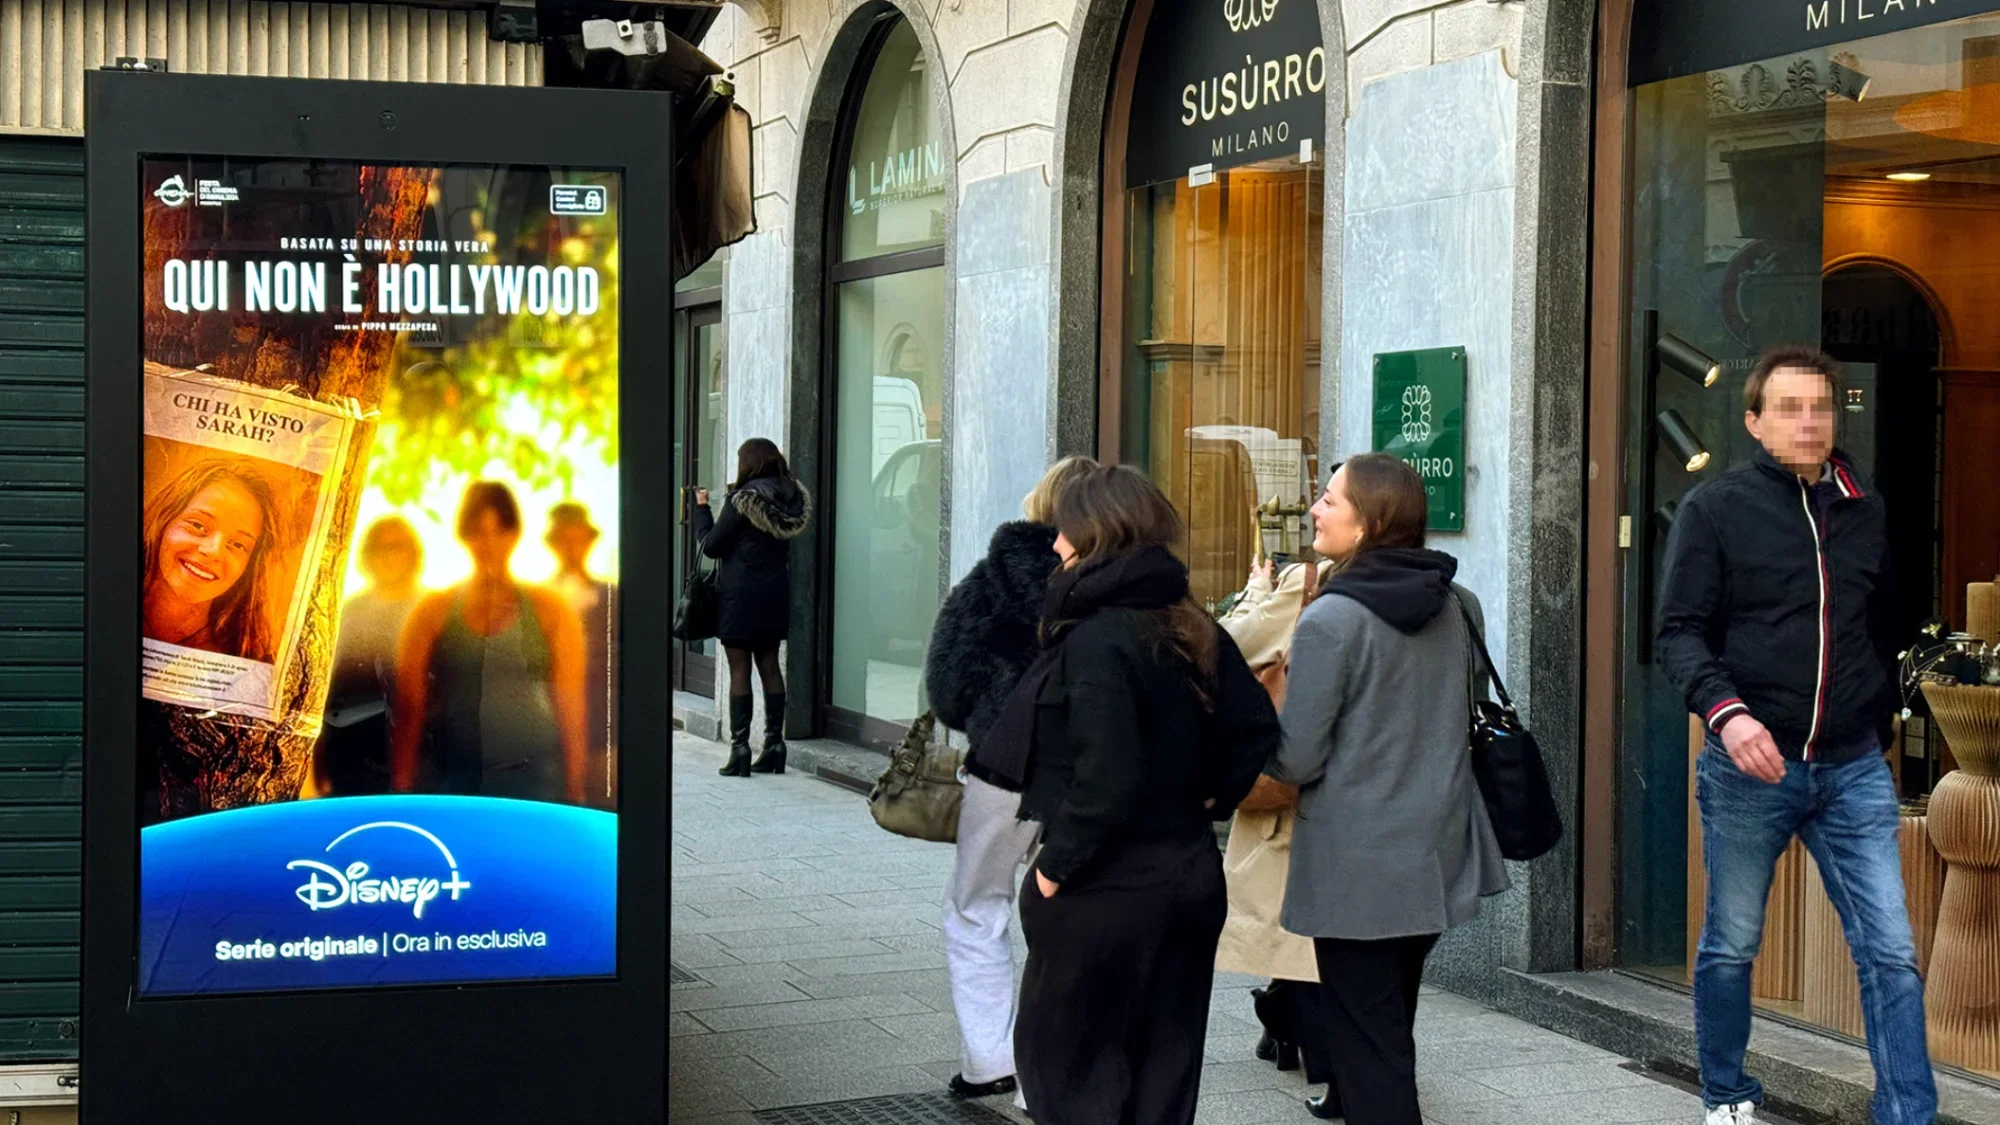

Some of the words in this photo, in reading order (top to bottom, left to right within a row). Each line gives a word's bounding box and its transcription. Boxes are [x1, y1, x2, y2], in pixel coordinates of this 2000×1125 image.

[1806, 0, 1937, 31] MILA
[1181, 46, 1326, 126] SUSÙRRO
[1212, 121, 1289, 157] MILANO
[280, 237, 334, 250] BASATA
[340, 238, 358, 251] SU
[364, 239, 393, 251] UNA
[398, 239, 448, 253] STORIA
[455, 240, 489, 253] VERA
[164, 258, 228, 314] QUI
[245, 260, 326, 313] NON
[342, 253, 363, 313] È
[378, 262, 599, 316] HOLLYWOOD
[361, 322, 387, 332] PIPPO
[389, 322, 438, 332] MEZZAPESA
[173, 393, 211, 413] CHI
[214, 401, 242, 420] HA
[248, 407, 304, 434] VISTO
[196, 414, 275, 443] SARAH?
[1402, 452, 1454, 478] ÙRRO
[215, 938, 276, 961] Serie
[279, 935, 378, 961] originale
[392, 932, 430, 953] Ora
[434, 931, 452, 951] in
[456, 928, 547, 951] esclusiva
